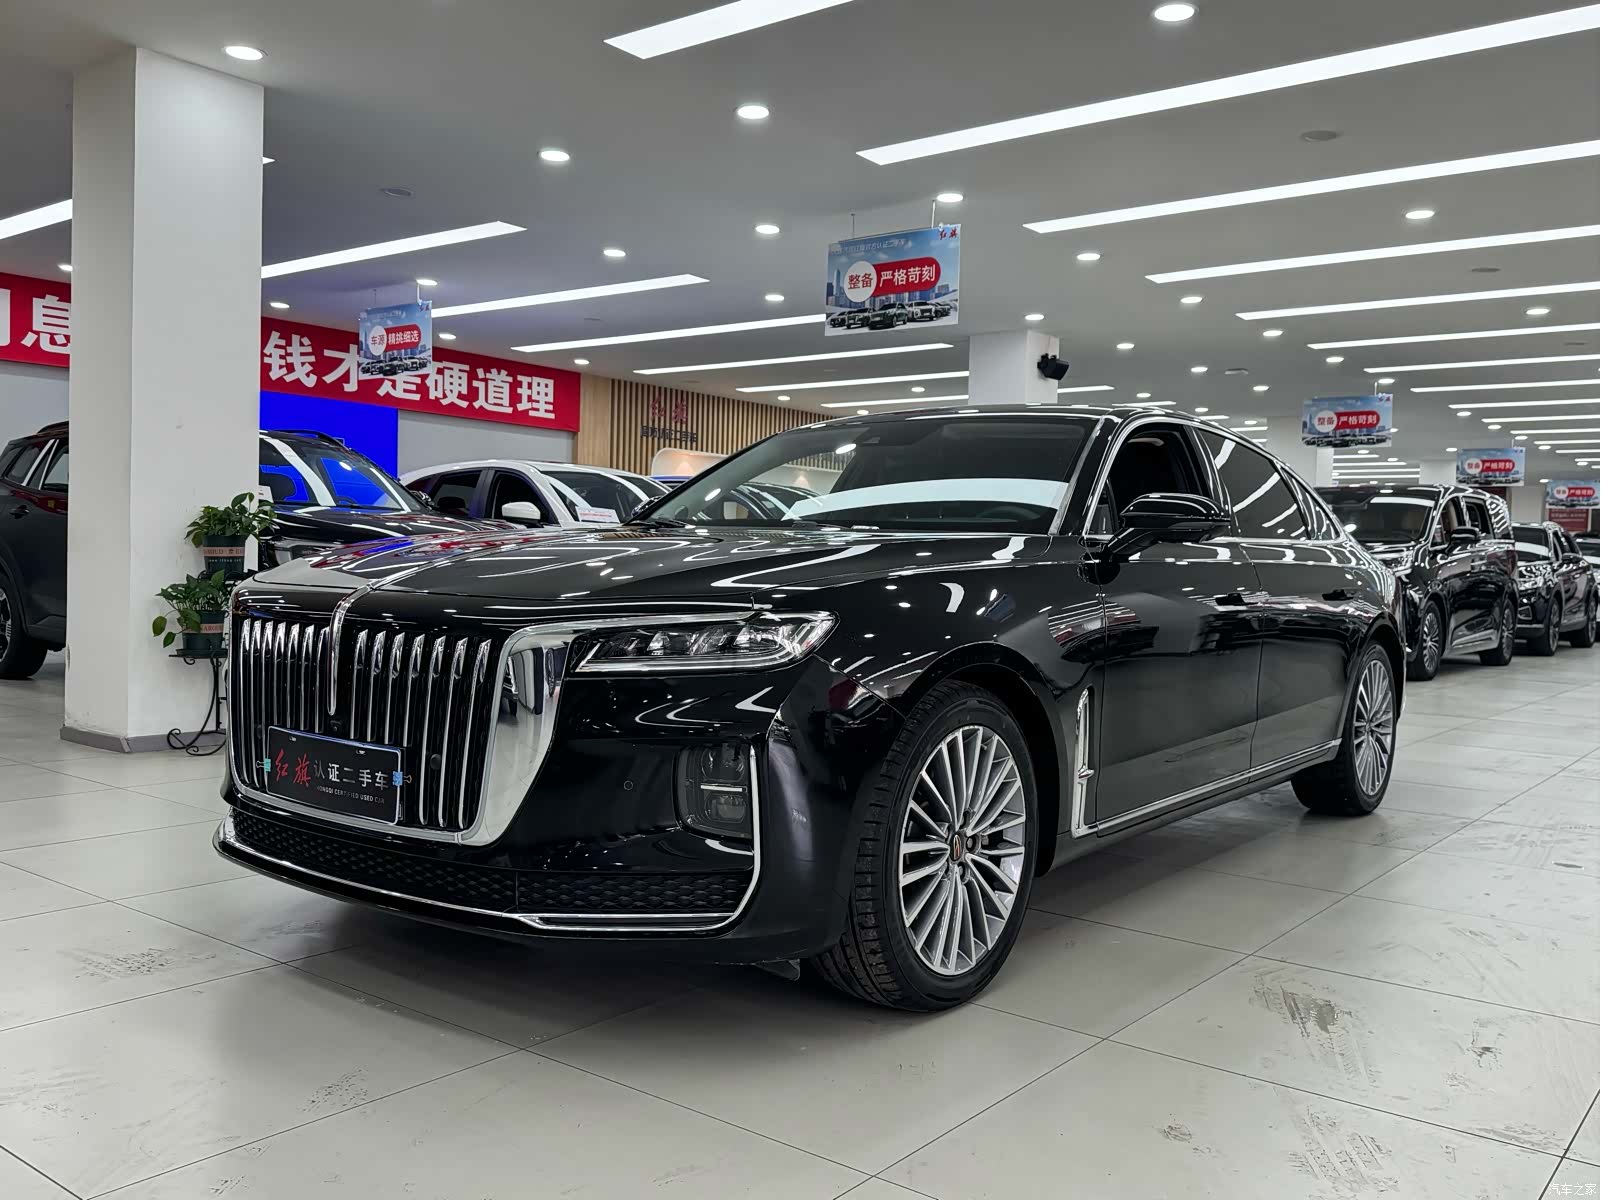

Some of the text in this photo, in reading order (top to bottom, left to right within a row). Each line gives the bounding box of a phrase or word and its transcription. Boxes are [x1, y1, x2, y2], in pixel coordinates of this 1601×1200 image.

[847, 264, 936, 290] 整备 严格苛刻
[0, 287, 71, 354] 息
[370, 334, 385, 346] 车源
[313, 760, 389, 791] 认证二手车
